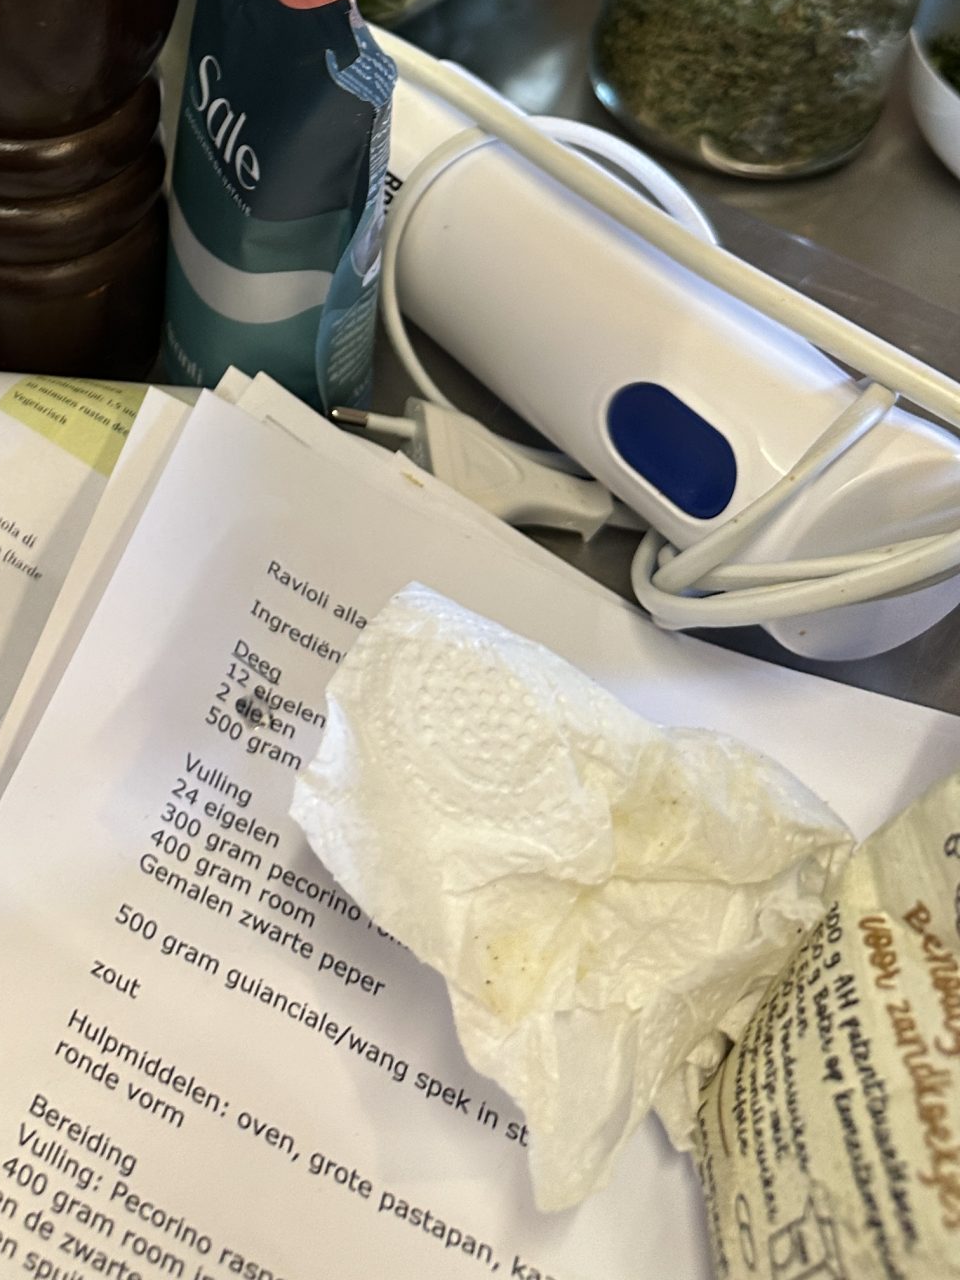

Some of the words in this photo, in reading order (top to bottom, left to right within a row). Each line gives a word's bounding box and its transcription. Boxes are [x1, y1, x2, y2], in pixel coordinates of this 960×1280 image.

[192, 55, 261, 191] Sale
[13, 390, 68, 426] Vegetarisch
[1, 548, 43, 581] (harde
[22, 528, 37, 549] di
[267, 560, 330, 610] Ravioli
[332, 601, 369, 631] alla
[232, 639, 283, 685] Deeg
[249, 599, 347, 665] Ingrediën
[216, 682, 232, 703] 2
[226, 663, 250, 688] 12
[253, 682, 328, 729] eigelen
[205, 705, 243, 741] 500
[246, 734, 303, 772] gram
[170, 778, 199, 806] 24
[203, 798, 281, 848] eigelen
[184, 752, 254, 809] Vulling
[150, 829, 191, 862] 400
[194, 857, 252, 896] gram
[259, 887, 317, 928] room
[160, 803, 201, 839] 300
[205, 830, 263, 870] gram
[267, 859, 363, 922] pecorino
[139, 853, 234, 918] Gemalen
[238, 908, 315, 960] zwarte
[318, 951, 386, 998] peper
[858, 915, 902, 990] voor
[90, 959, 142, 1000] zout
[833, 973, 860, 1011] AH
[114, 902, 158, 942] 500
[161, 931, 221, 975] gram
[225, 967, 410, 1083] guianciale/wang
[414, 1067, 471, 1115] spek
[477, 1100, 500, 1131] in
[54, 1038, 120, 1091] ronde
[127, 1082, 186, 1129] vorm
[29, 1093, 139, 1179] Bereiding
[68, 1008, 230, 1118] Hulpmiddelen:
[237, 1111, 301, 1163] oven,
[308, 1150, 374, 1200] grote
[378, 1189, 501, 1272] pastapan,
[2, 1156, 48, 1197] 400
[50, 1190, 116, 1238] gram
[121, 1229, 186, 1279] room
[17, 1122, 105, 1192] Vulling:
[110, 1180, 212, 1256] Pecorino
[24, 1210, 55, 1242] de
